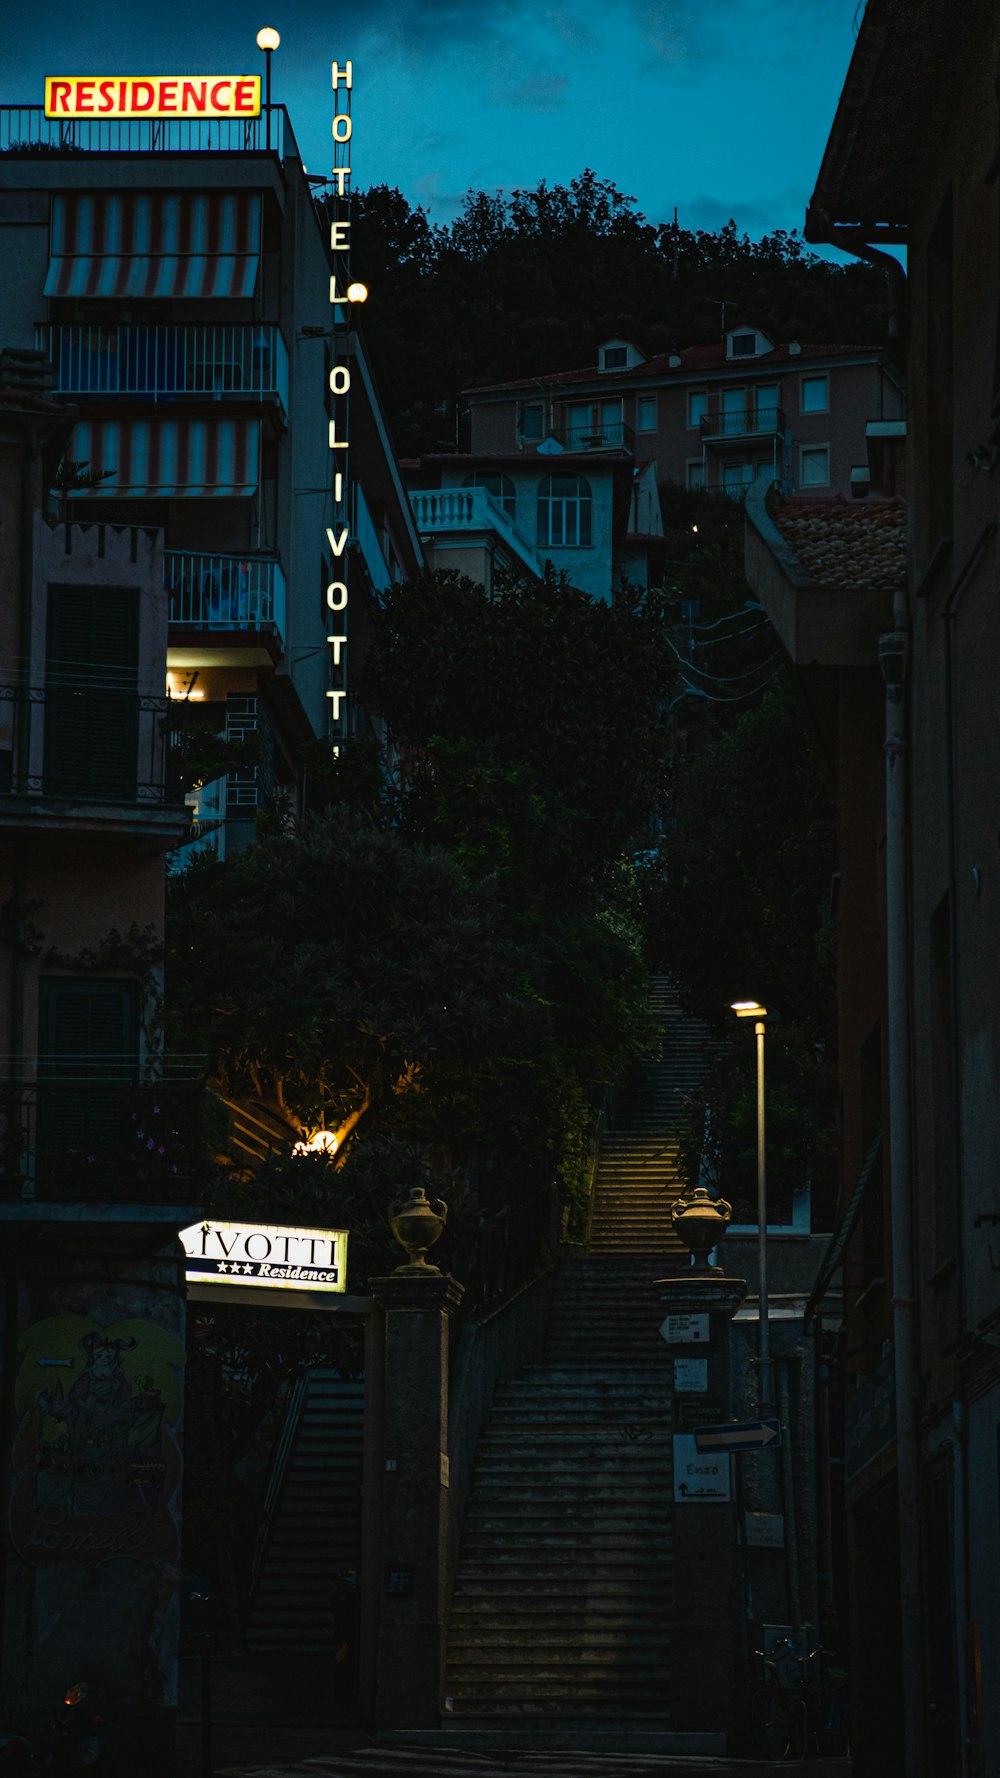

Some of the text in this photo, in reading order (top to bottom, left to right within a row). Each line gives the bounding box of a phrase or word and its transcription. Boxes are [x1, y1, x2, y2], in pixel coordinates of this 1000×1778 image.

[50, 81, 255, 112] RESIDENCE
[330, 61, 353, 304] HOTEL
[185, 1224, 339, 1266] IVOTTI
[257, 1263, 336, 1282] Residence
[686, 1463, 719, 1475] Enzo
